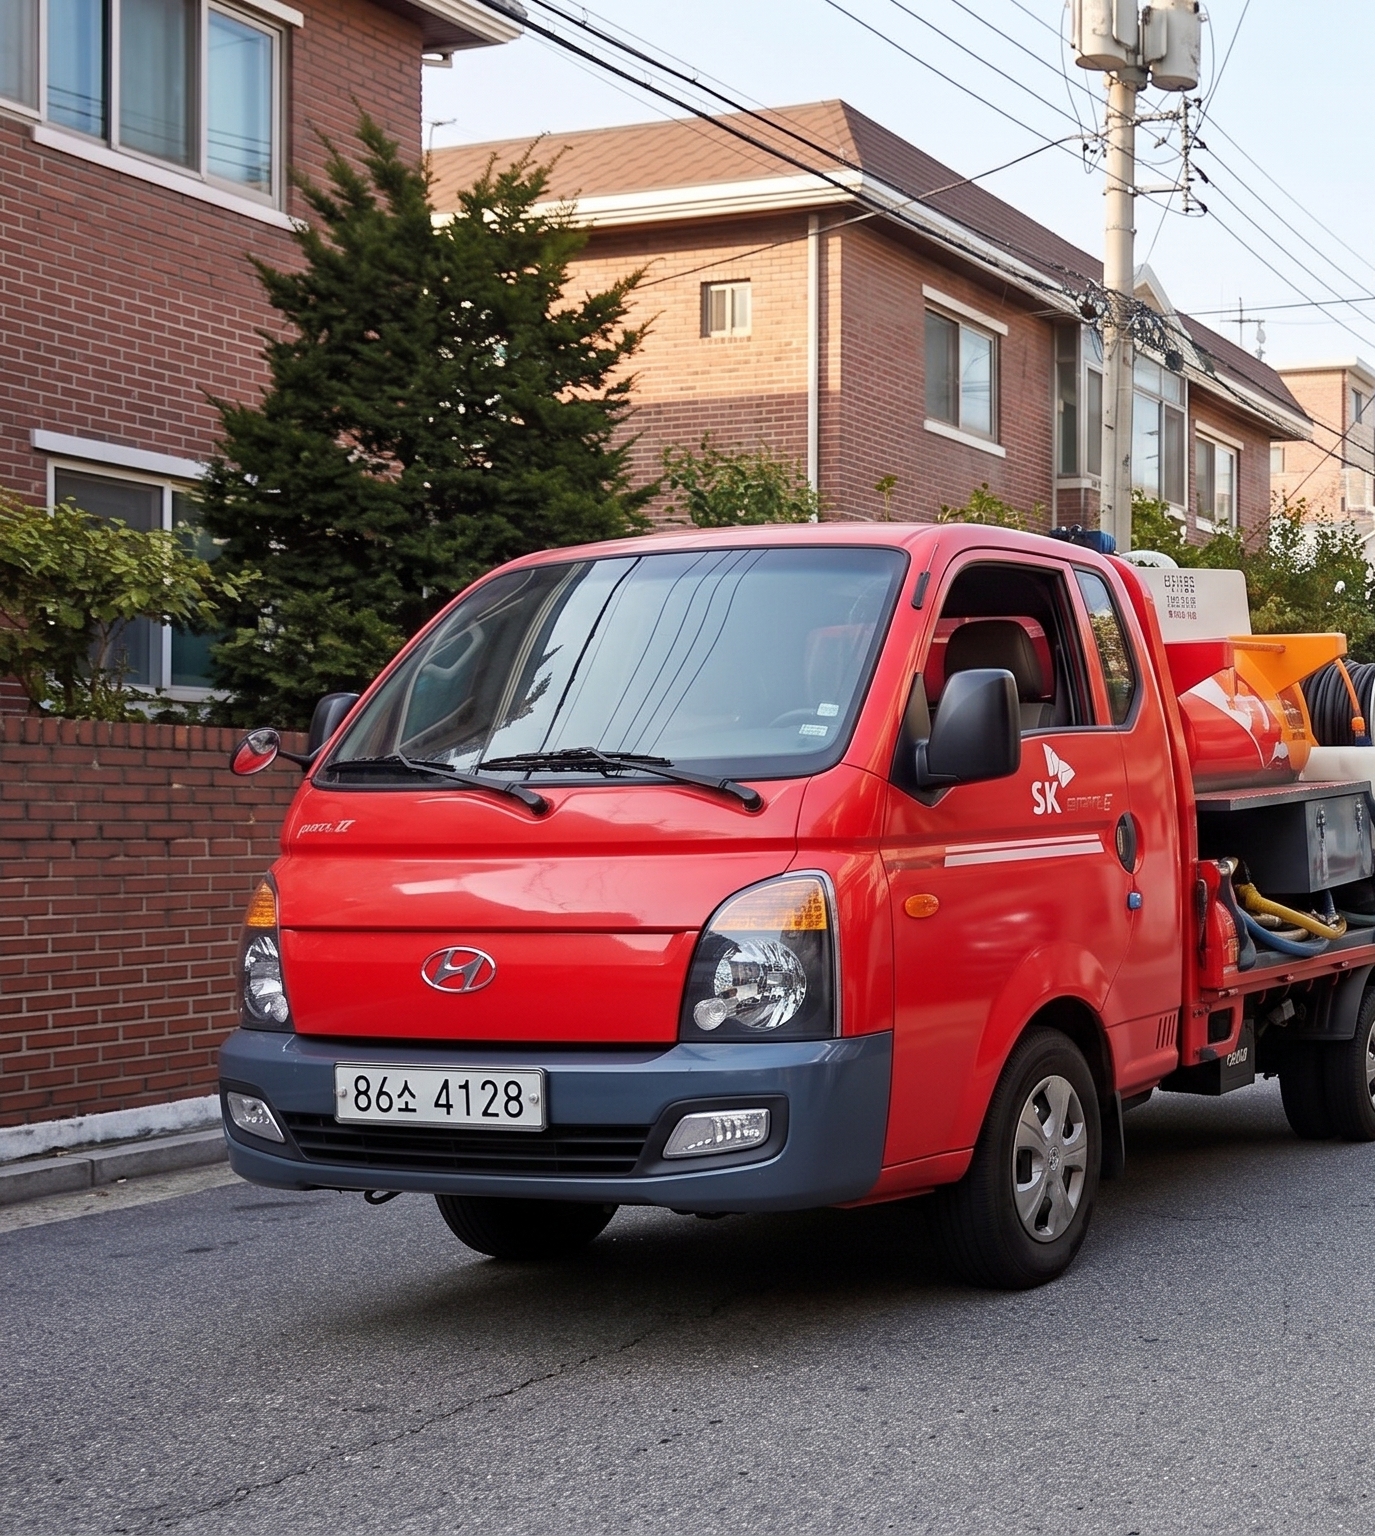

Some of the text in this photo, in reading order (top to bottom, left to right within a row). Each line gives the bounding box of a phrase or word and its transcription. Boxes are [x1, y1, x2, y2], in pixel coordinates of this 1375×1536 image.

[1031, 781, 1062, 815] SK
[354, 1075, 524, 1118] 86소 4128
